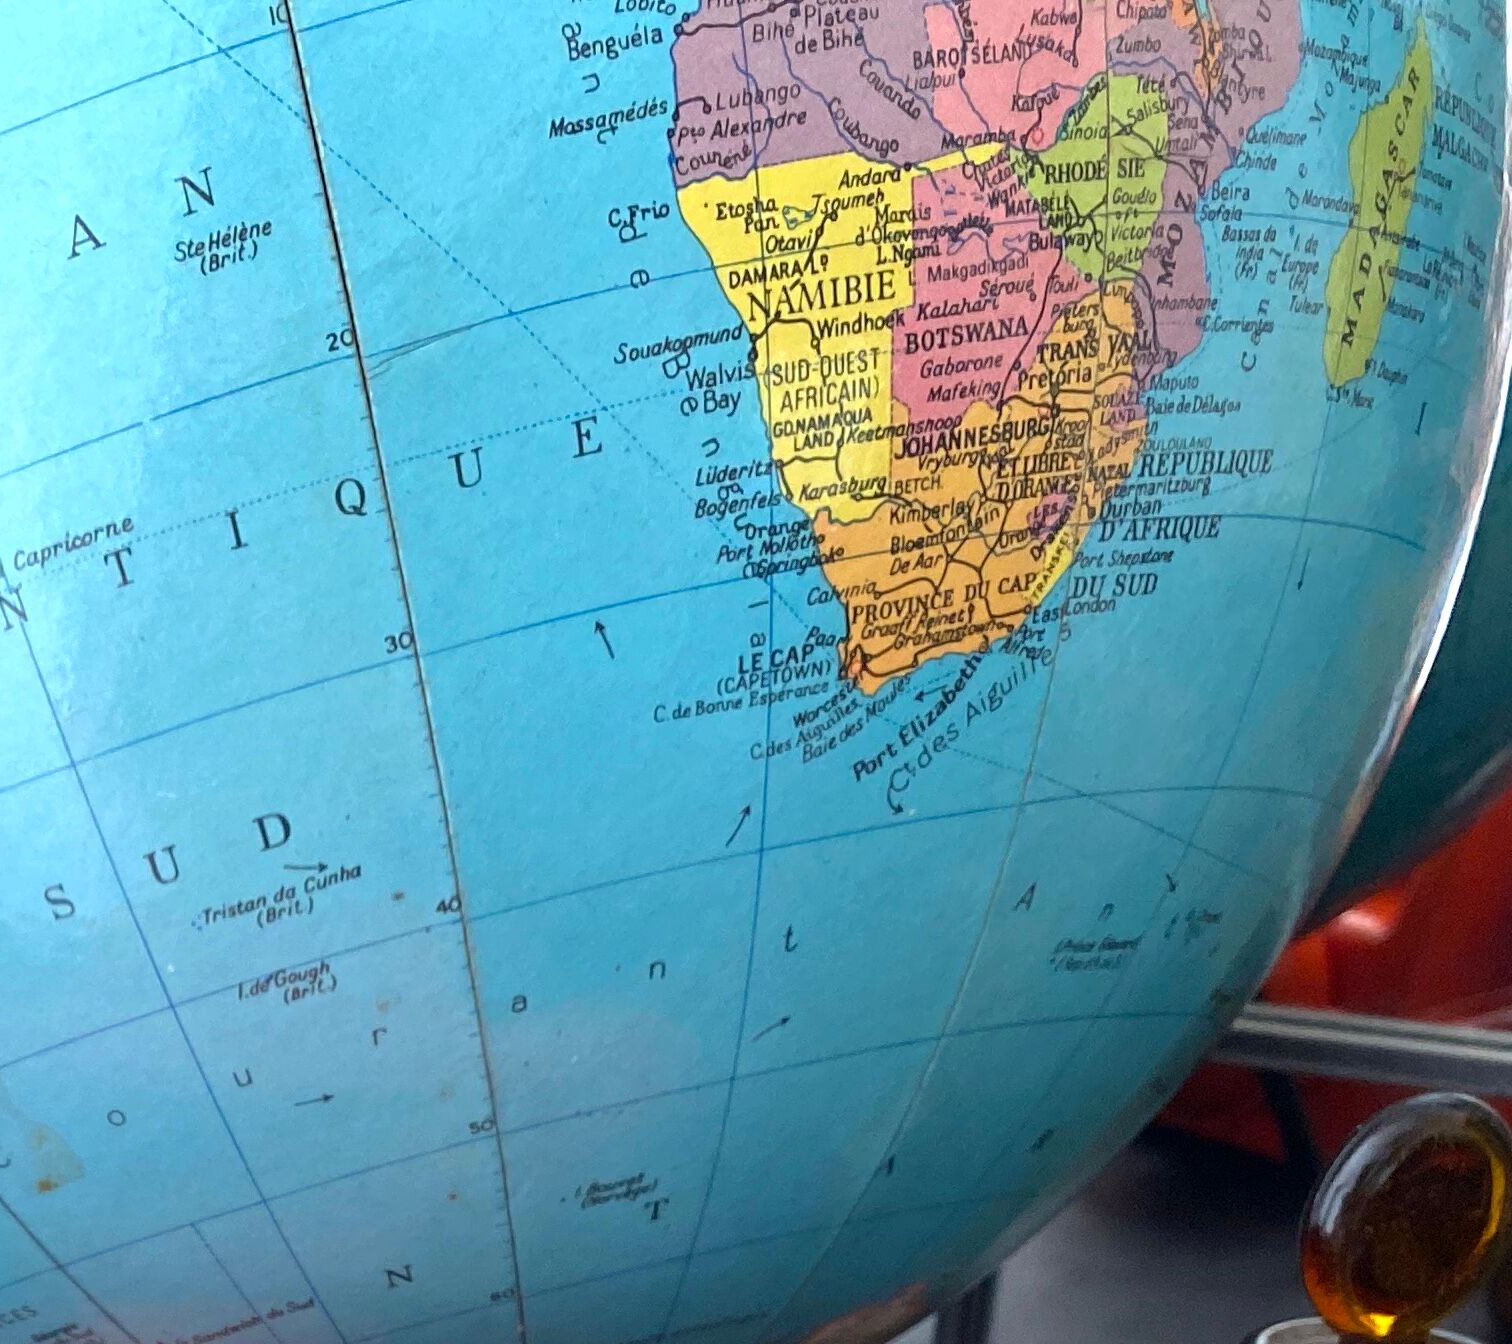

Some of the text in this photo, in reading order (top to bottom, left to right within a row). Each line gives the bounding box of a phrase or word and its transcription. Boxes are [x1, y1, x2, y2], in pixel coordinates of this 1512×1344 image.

[716, 84, 801, 112] Lubango
[710, 110, 807, 141] Alexandre
[1212, 184, 1250, 201] Beira
[746, 268, 896, 322] NAMIBIE
[916, 295, 999, 322] Kalahari
[817, 312, 904, 339] Windhoek
[904, 316, 1030, 355] BOTSWANA
[685, 362, 756, 392] Walvis
[920, 353, 1003, 379] Gaborone
[704, 391, 741, 417] Bay
[927, 378, 1002, 404] Mafeking
[794, 431, 834, 451] LAND
[895, 415, 1050, 461] JOHANNESBURG
[800, 476, 887, 502] Karasburg
[13, 515, 135, 572] Capricorne
[890, 555, 912, 575] De
[1070, 572, 1158, 600] DU SUD
[852, 592, 955, 625] PROVINCE
[739, 644, 815, 674] LE CAP
[673, 702, 690, 718] de
[853, 646, 987, 782] Port Elizabeth
[918, 723, 960, 769] des
[201, 863, 362, 927] Tristan da Cunha
